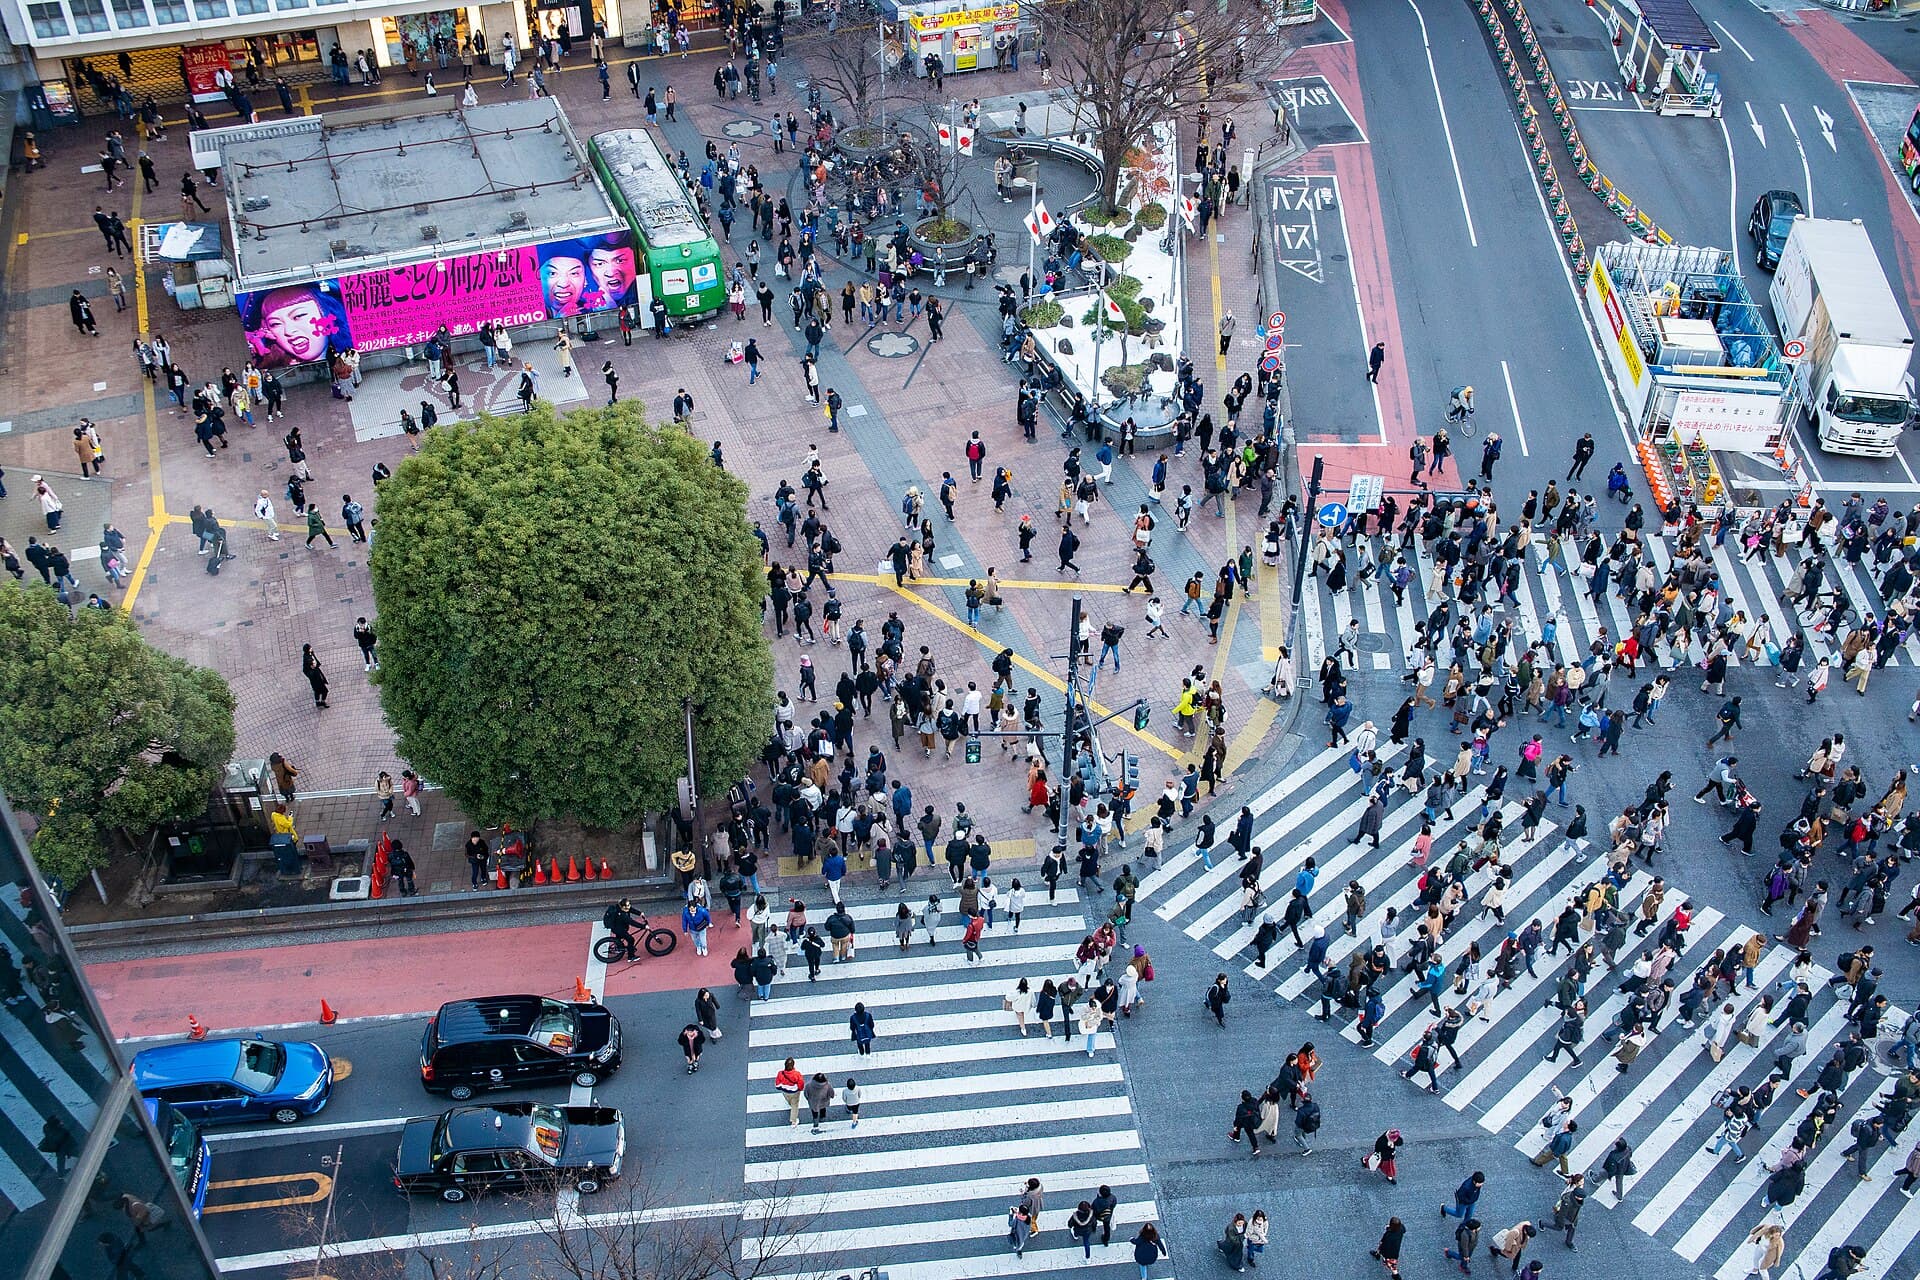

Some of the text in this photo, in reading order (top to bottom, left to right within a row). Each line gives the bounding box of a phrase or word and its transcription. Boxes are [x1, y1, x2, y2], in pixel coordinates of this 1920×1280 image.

[1273, 187, 1333, 210] バス停
[1274, 225, 1312, 249] バス
